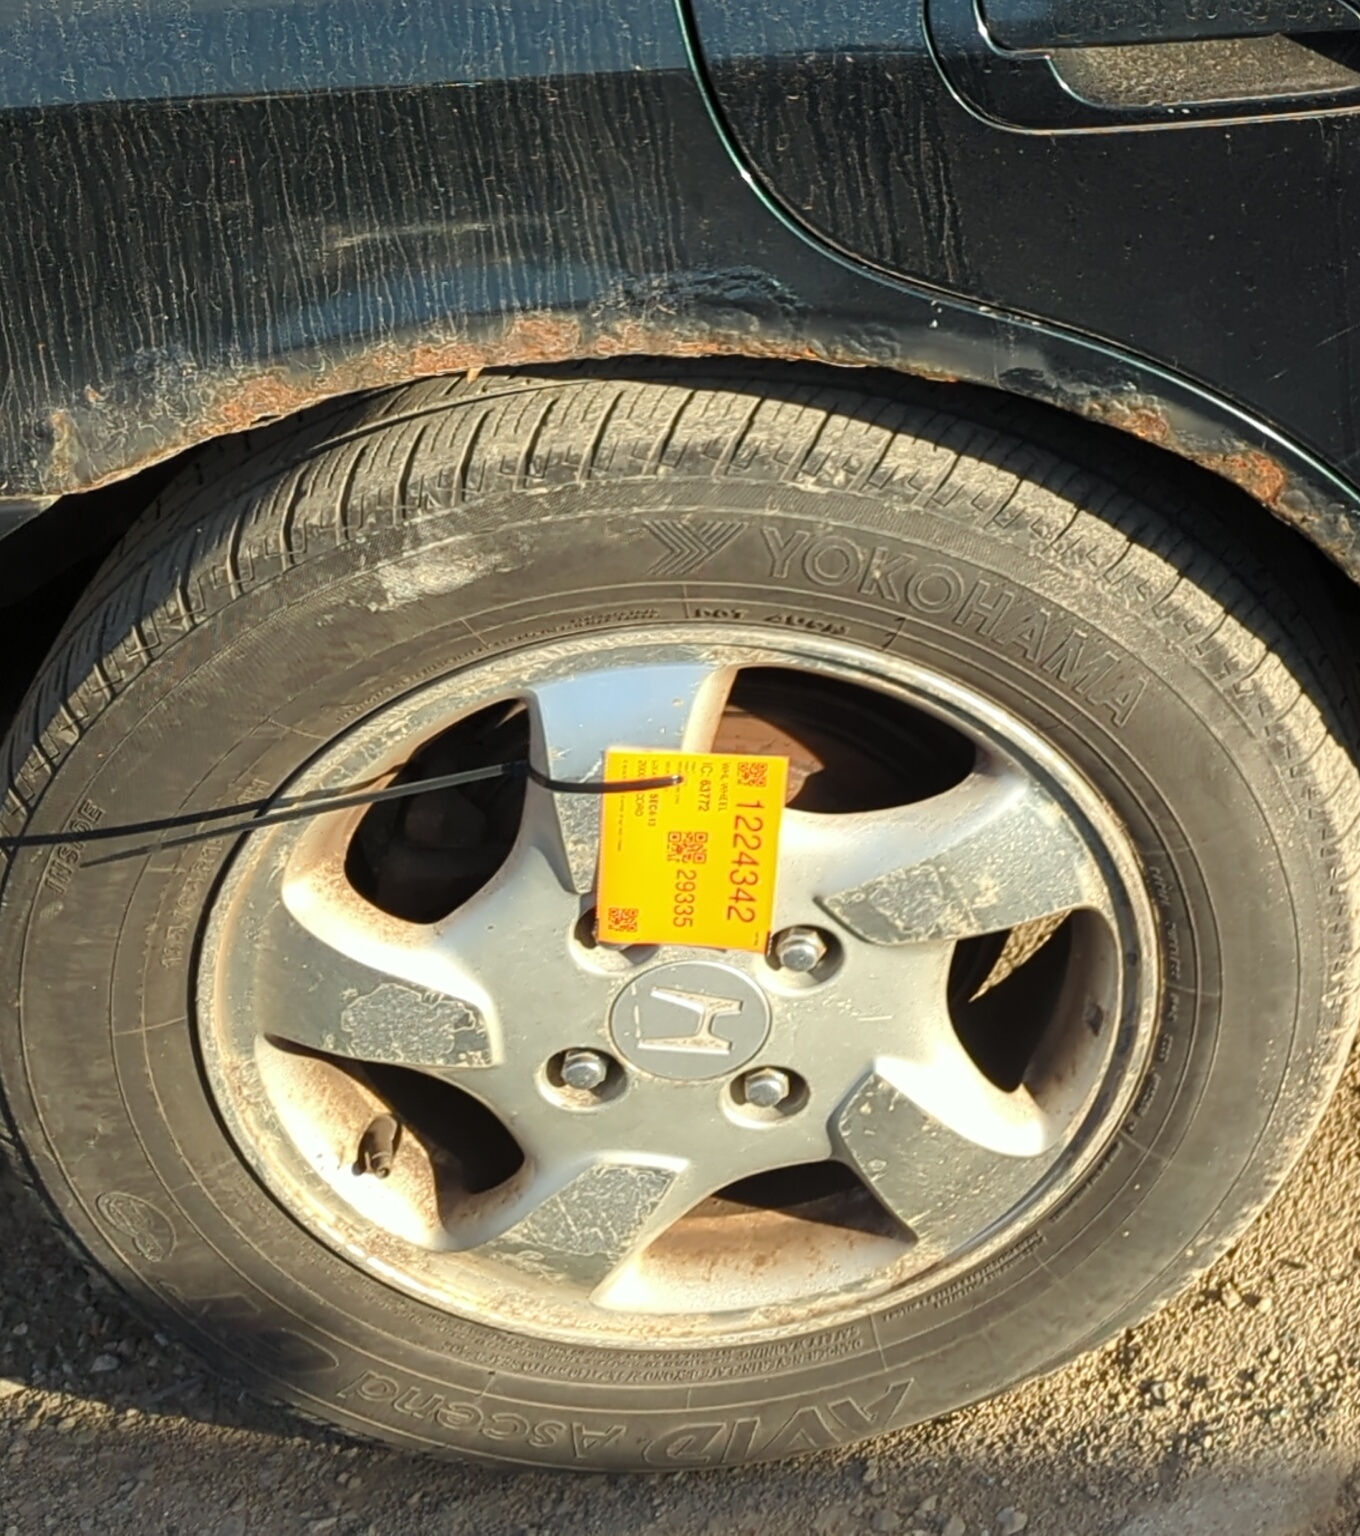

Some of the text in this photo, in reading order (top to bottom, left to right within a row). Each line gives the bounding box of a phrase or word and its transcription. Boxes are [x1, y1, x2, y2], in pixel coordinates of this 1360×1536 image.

[761, 526, 1149, 726] YOKOHAMA
[698, 779, 712, 812] 63772
[718, 782, 728, 812] WHEEL
[673, 869, 698, 928] 29335
[726, 799, 766, 924] 1224342
[336, 1370, 625, 1461] Ascend
[642, 1378, 915, 1467] AVID
